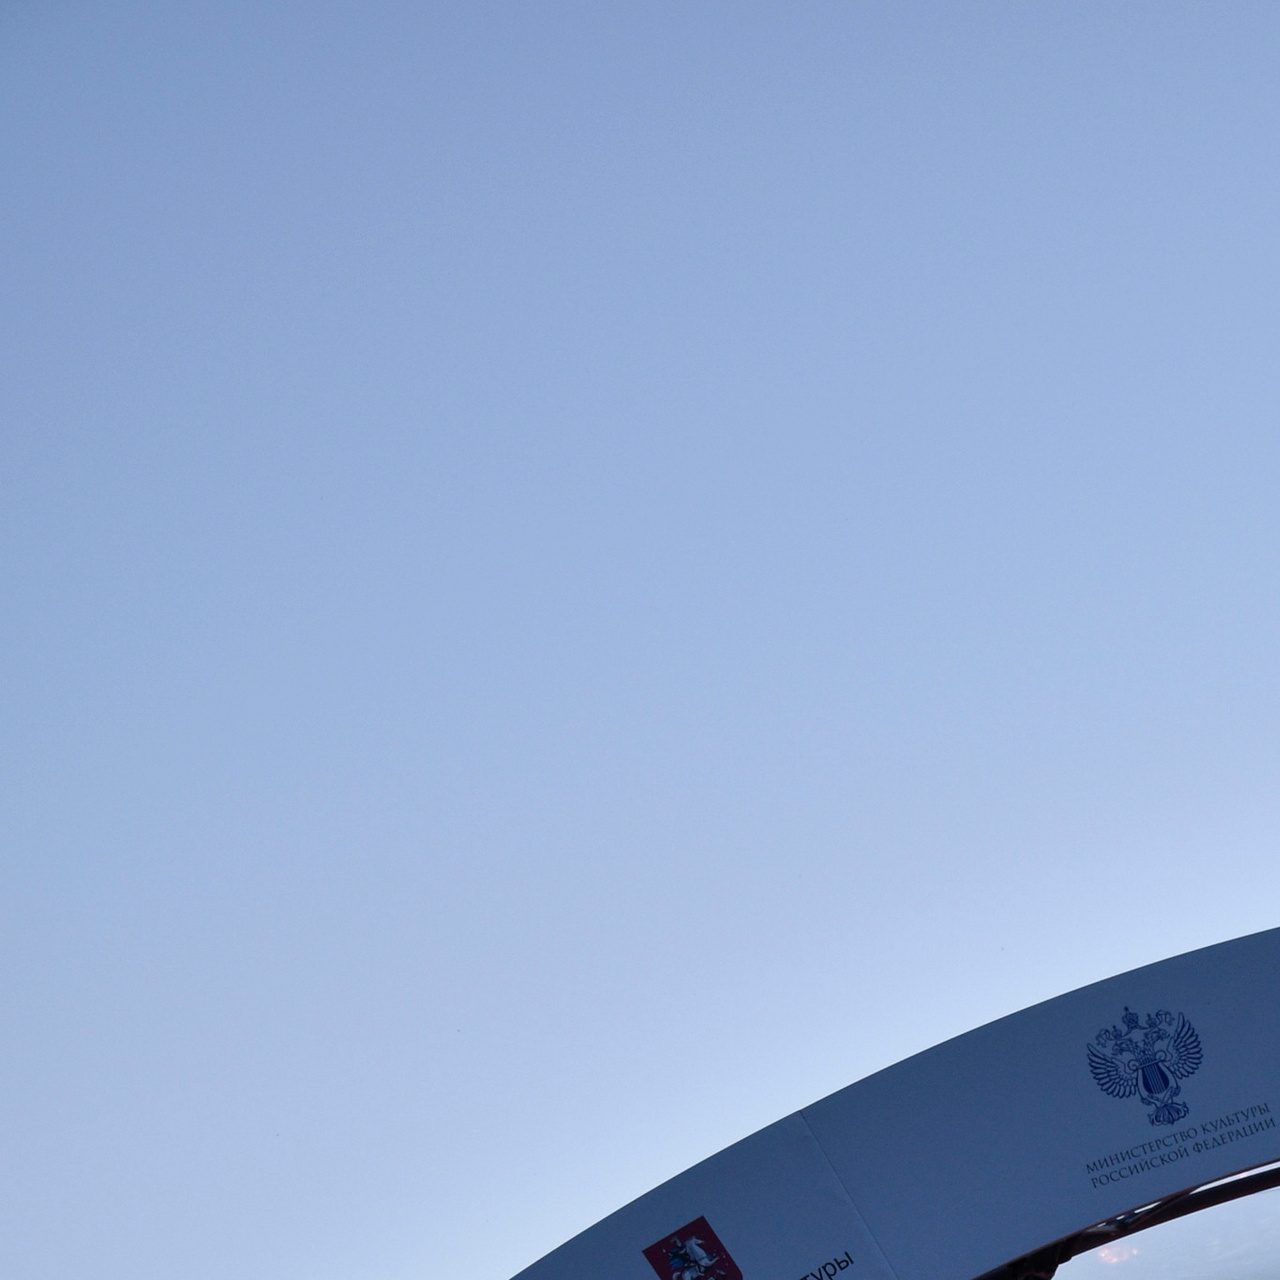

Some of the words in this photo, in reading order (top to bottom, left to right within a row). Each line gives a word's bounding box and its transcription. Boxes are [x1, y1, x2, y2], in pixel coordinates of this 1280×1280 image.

[1086, 1127, 1198, 1174] МИНИСТЕРСТВО
[1201, 1102, 1271, 1134] КУЛЬТУРЫ
[1091, 1146, 1190, 1188] РОССИЙСКОЙ
[1192, 1117, 1277, 1154] ФЕДЕРАЦИИ
